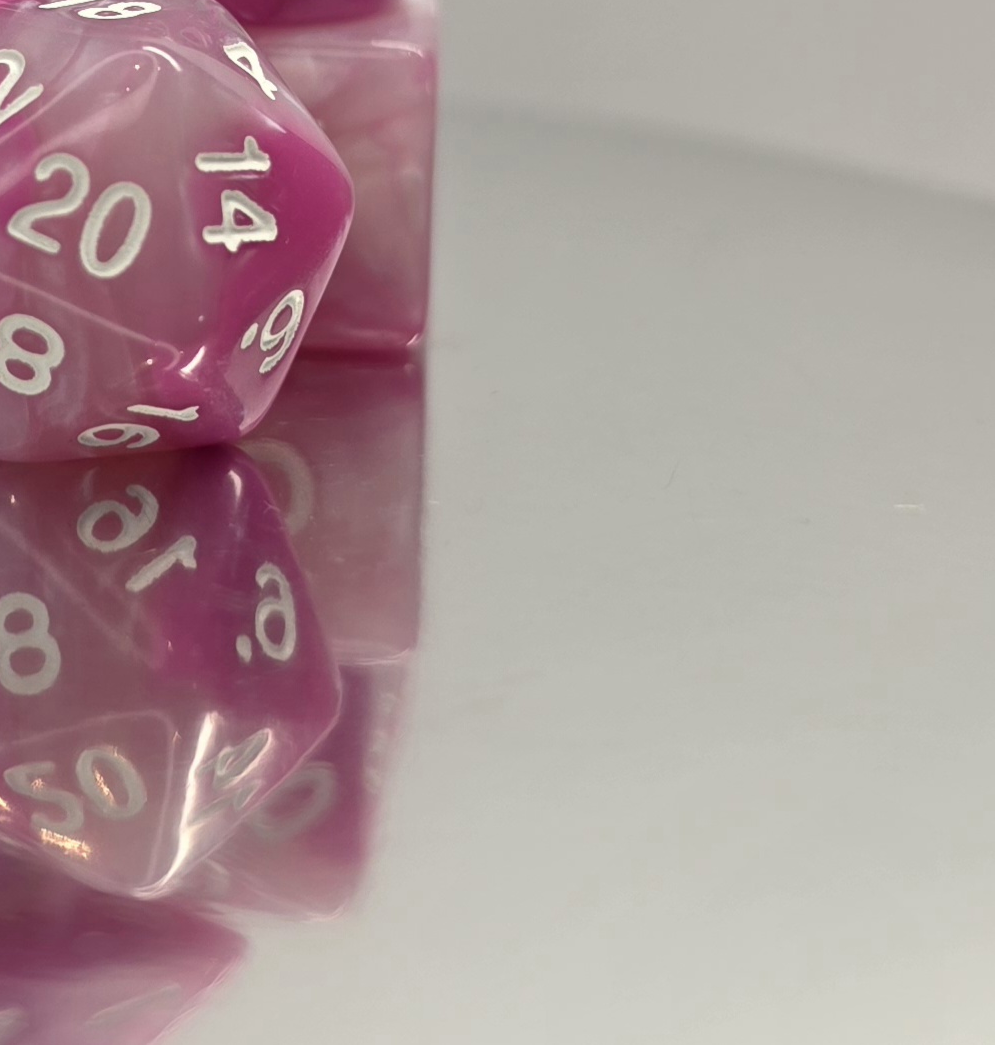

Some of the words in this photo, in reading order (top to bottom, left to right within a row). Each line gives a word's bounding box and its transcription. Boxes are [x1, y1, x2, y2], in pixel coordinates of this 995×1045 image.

[223, 40, 278, 101] 4
[6, 151, 155, 280] 20
[194, 135, 280, 253] 14
[76, 402, 201, 450] 16
